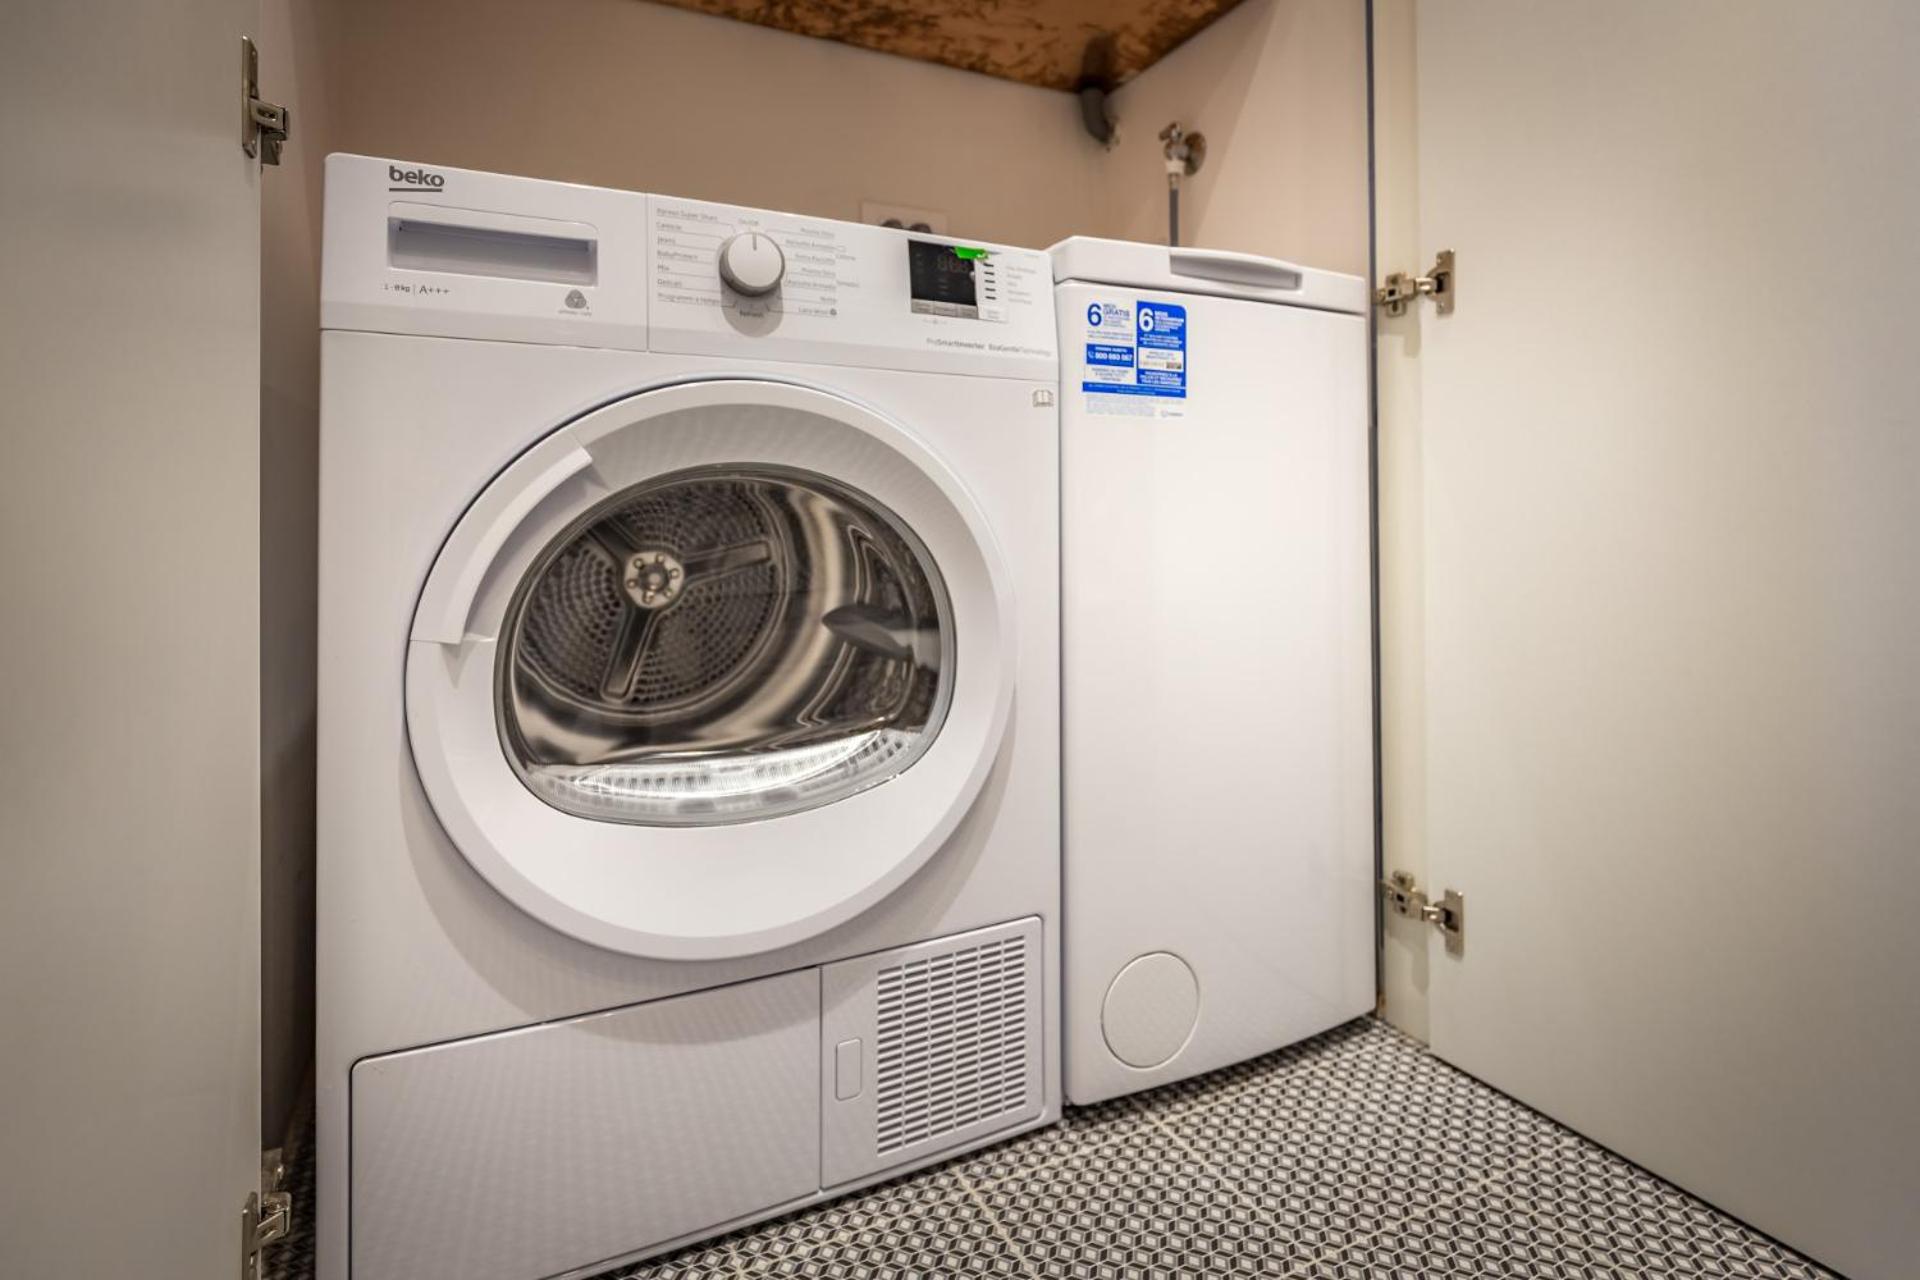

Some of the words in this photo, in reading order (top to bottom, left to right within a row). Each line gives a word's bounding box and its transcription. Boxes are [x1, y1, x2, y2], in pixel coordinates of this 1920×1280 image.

[389, 165, 445, 187] beko
[1087, 303, 1102, 326] 6
[1139, 308, 1154, 332] 6
